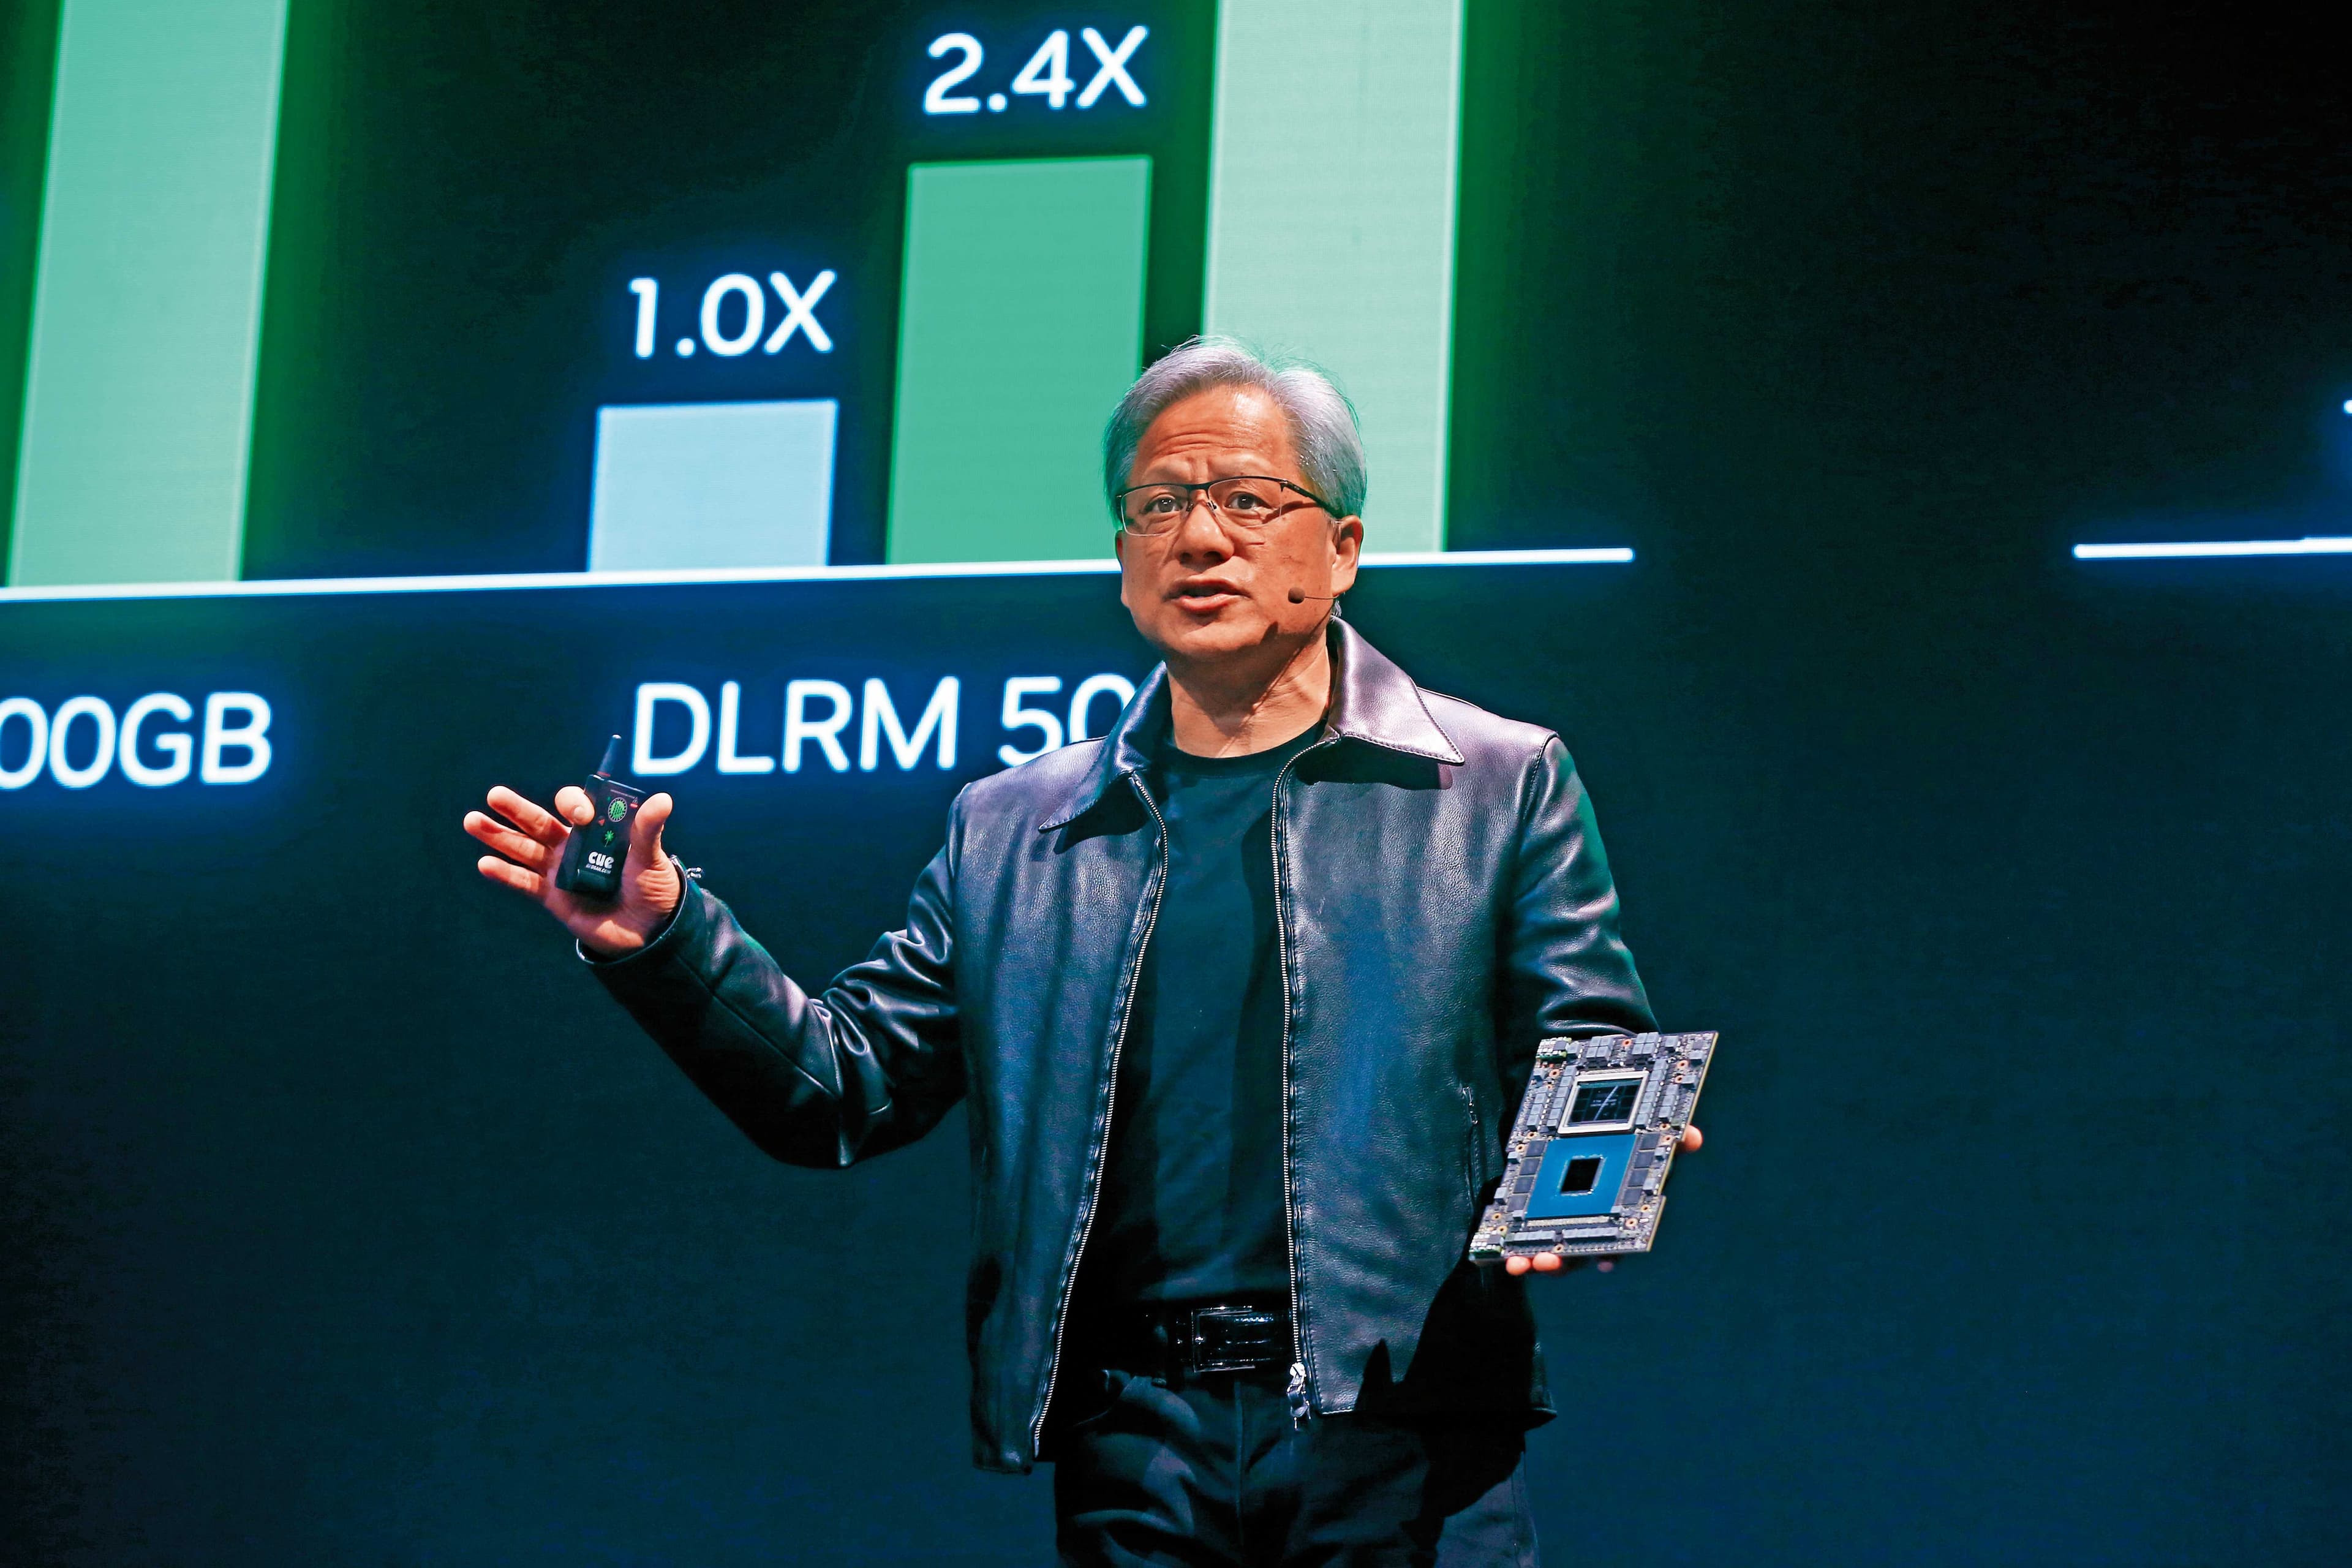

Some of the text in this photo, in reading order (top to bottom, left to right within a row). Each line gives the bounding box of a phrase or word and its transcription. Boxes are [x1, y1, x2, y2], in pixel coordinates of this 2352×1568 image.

[924, 25, 1147, 113] 2.4X
[630, 270, 835, 358] 1.0X
[633, 676, 959, 775] DLRM
